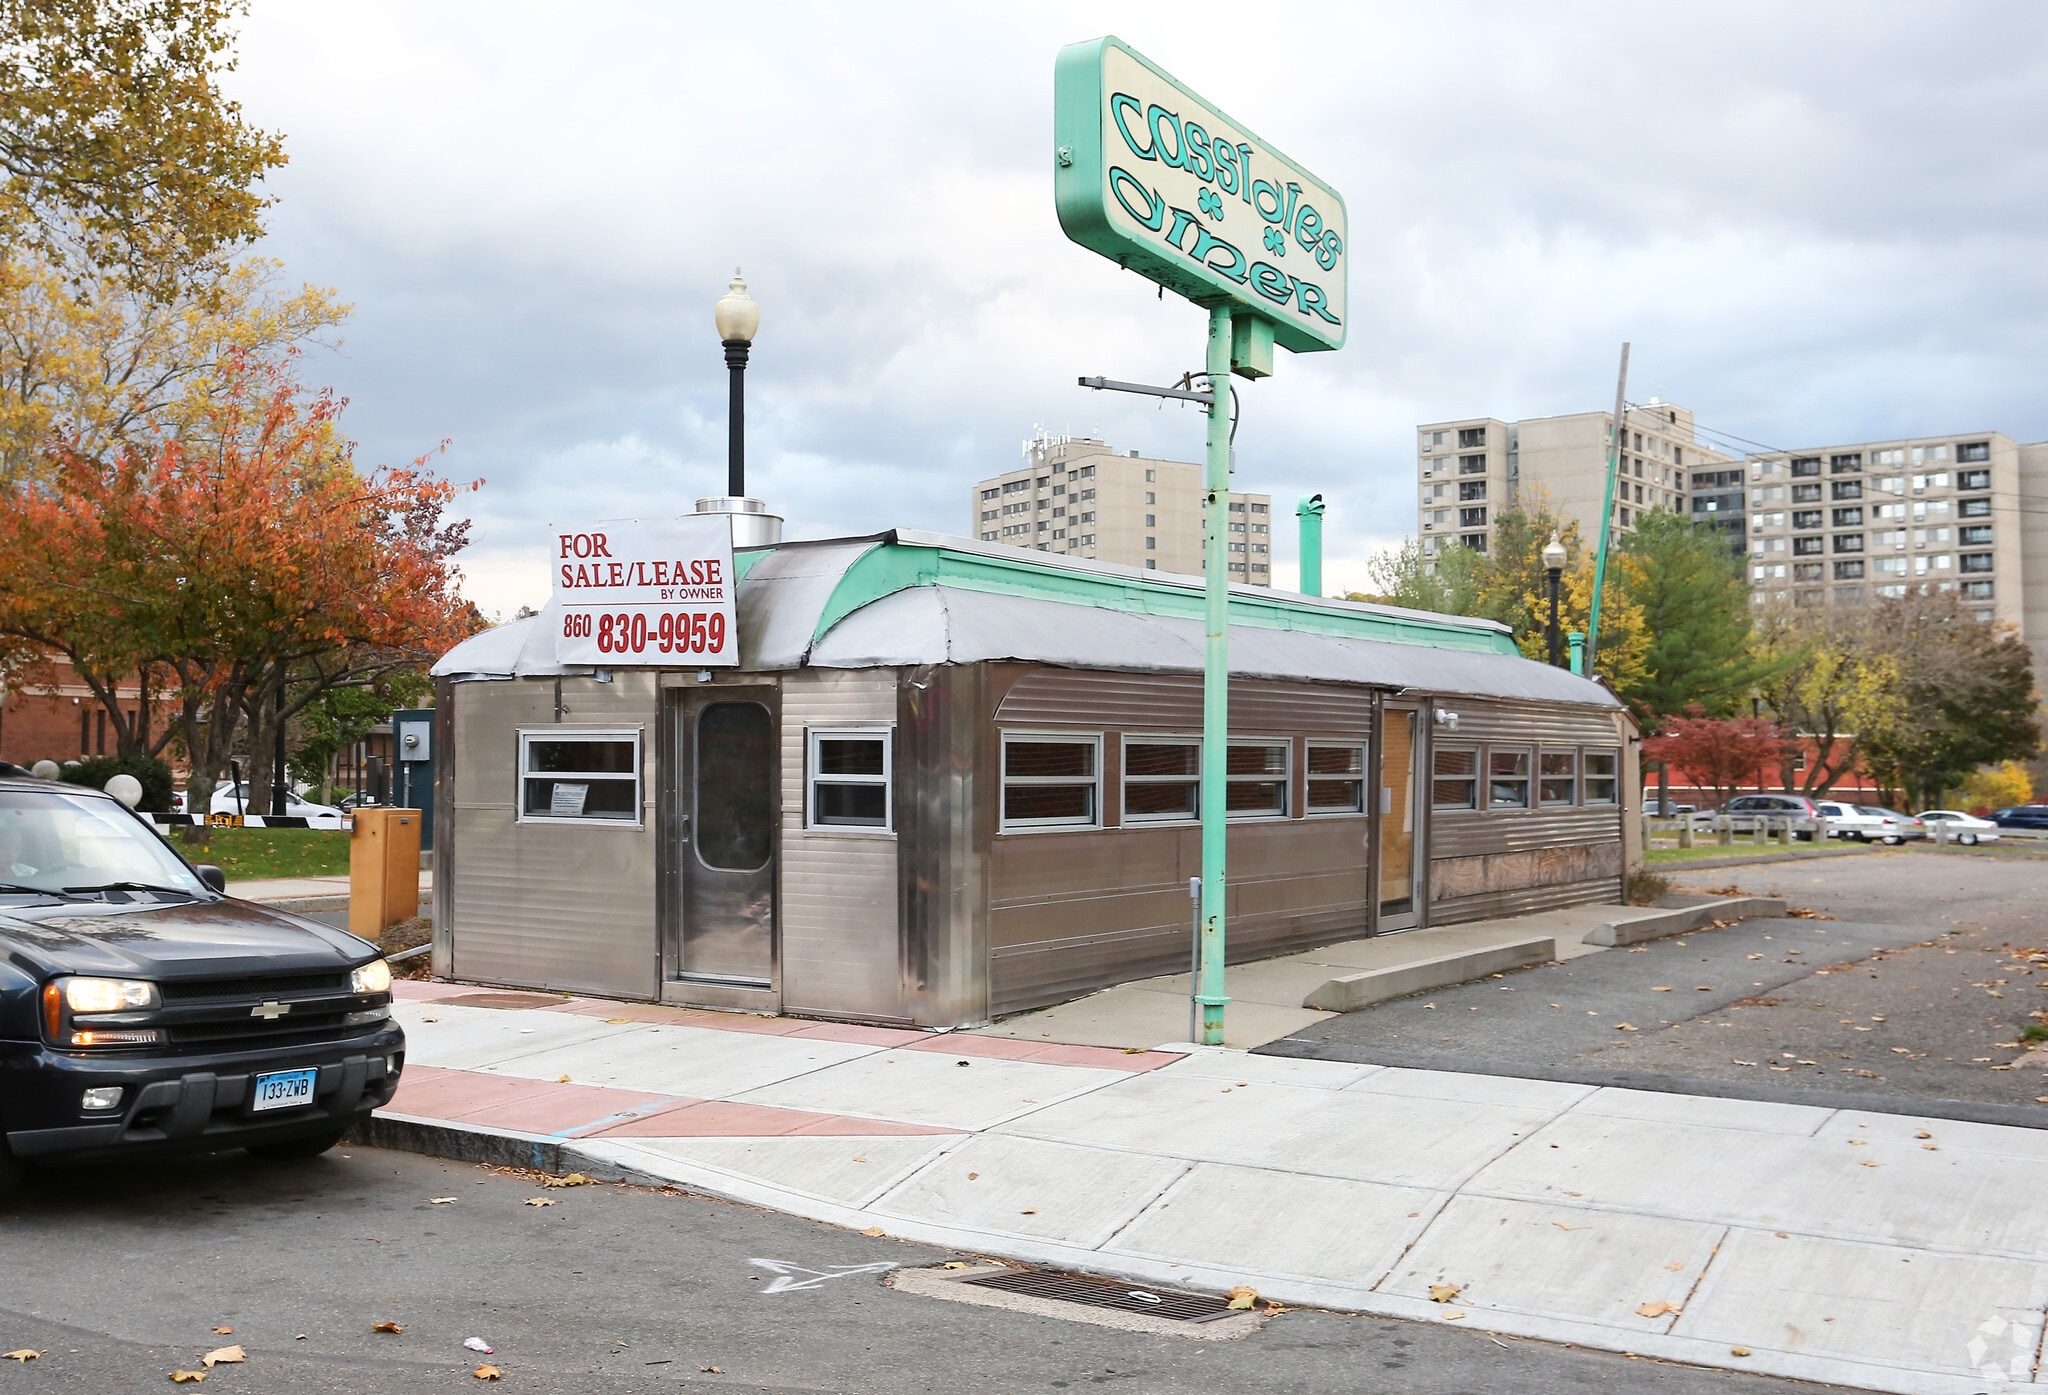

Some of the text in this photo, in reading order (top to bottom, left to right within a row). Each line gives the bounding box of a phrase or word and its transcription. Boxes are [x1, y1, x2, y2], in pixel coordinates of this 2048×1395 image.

[559, 533, 612, 558] FOR
[561, 559, 723, 588] SALE/LEASE
[661, 587, 723, 600] BY OWNER
[563, 612, 725, 653] 860 830-9959
